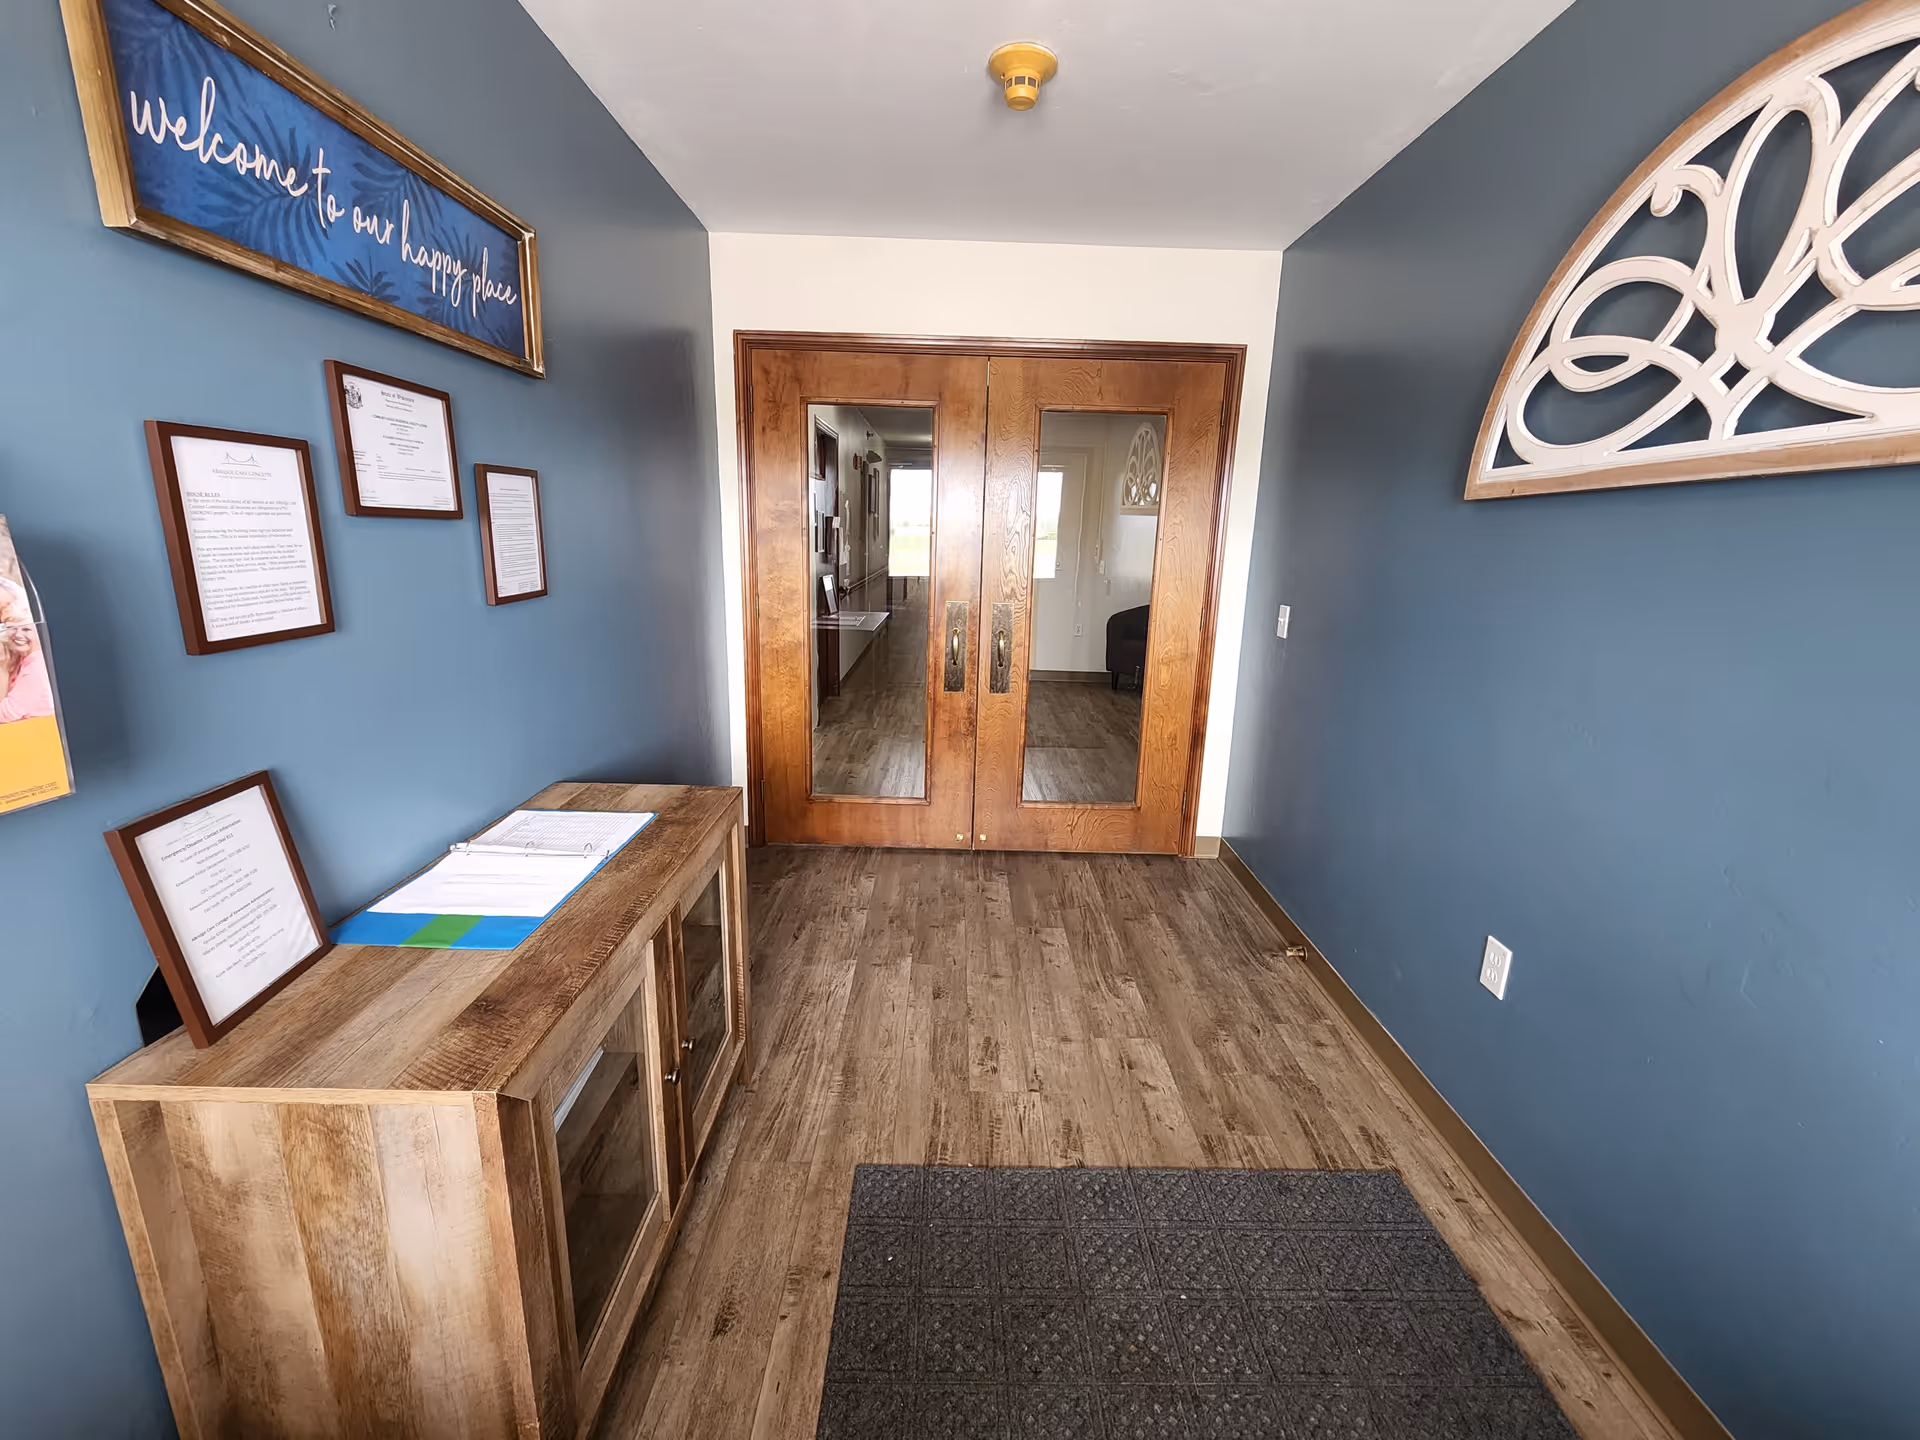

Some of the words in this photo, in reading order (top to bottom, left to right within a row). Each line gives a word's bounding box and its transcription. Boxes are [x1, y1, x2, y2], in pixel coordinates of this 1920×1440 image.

[130, 76, 308, 197] welcome
[312, 148, 345, 229] to
[352, 203, 395, 246] our
[400, 199, 467, 307] happy
[472, 247, 517, 317] place
[203, 830, 219, 840] Contact
